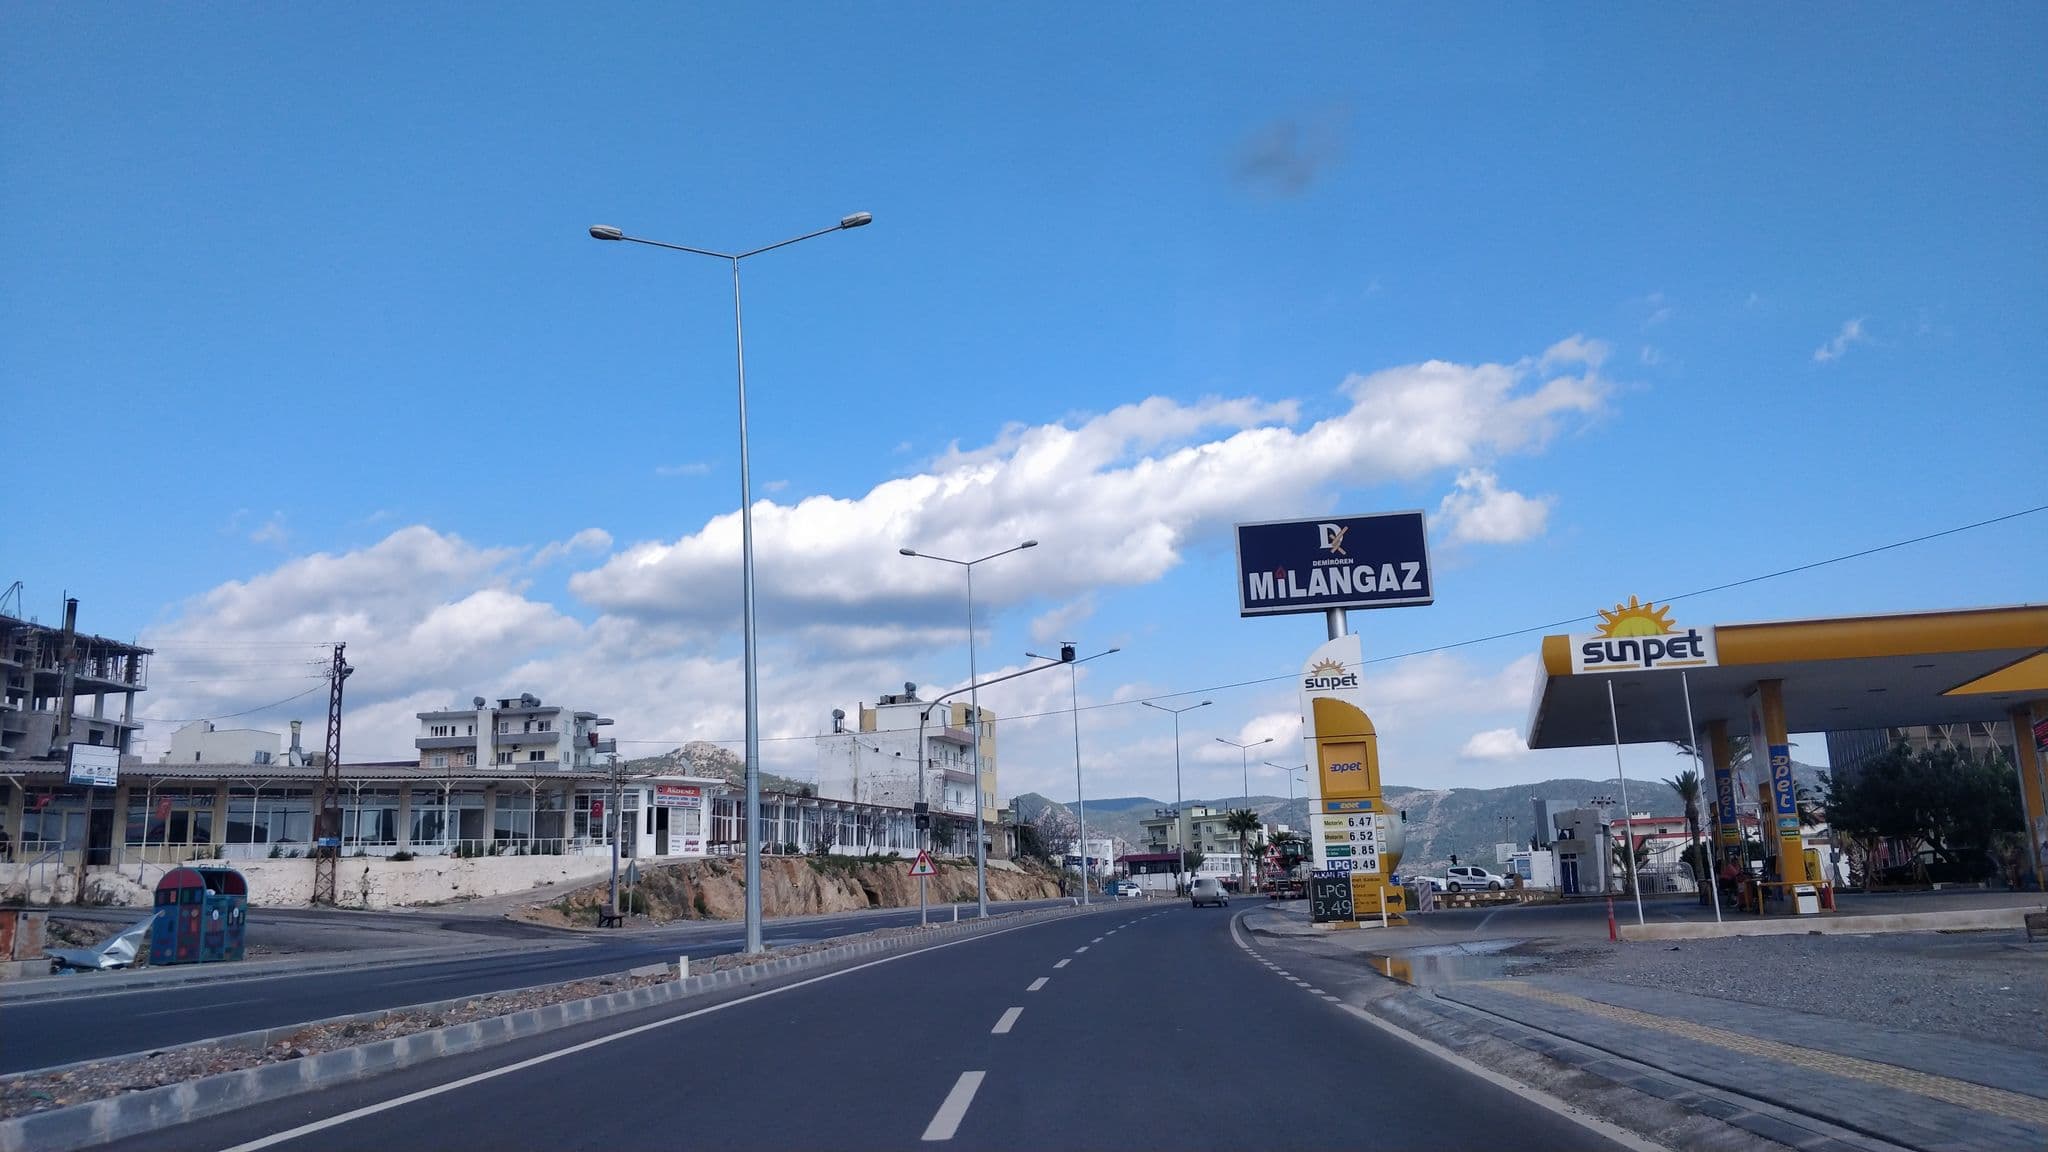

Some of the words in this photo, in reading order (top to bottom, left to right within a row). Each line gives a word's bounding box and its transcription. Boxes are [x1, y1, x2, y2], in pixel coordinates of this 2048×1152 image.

[1312, 558, 1354, 567] DEMİRÖREN
[1582, 629, 1705, 667] sunpet
[1305, 672, 1358, 690] sunpet
[1330, 761, 1362, 773] opet
[1771, 755, 1791, 808] opet
[1348, 817, 1372, 827] 6.47
[1350, 831, 1374, 841] 6.52
[1351, 845, 1376, 856] 6.85
[1328, 860, 1351, 871] LPG
[1352, 859, 1376, 870] 3.49
[1318, 884, 1347, 898] LPG
[1315, 900, 1352, 916] 3.49
